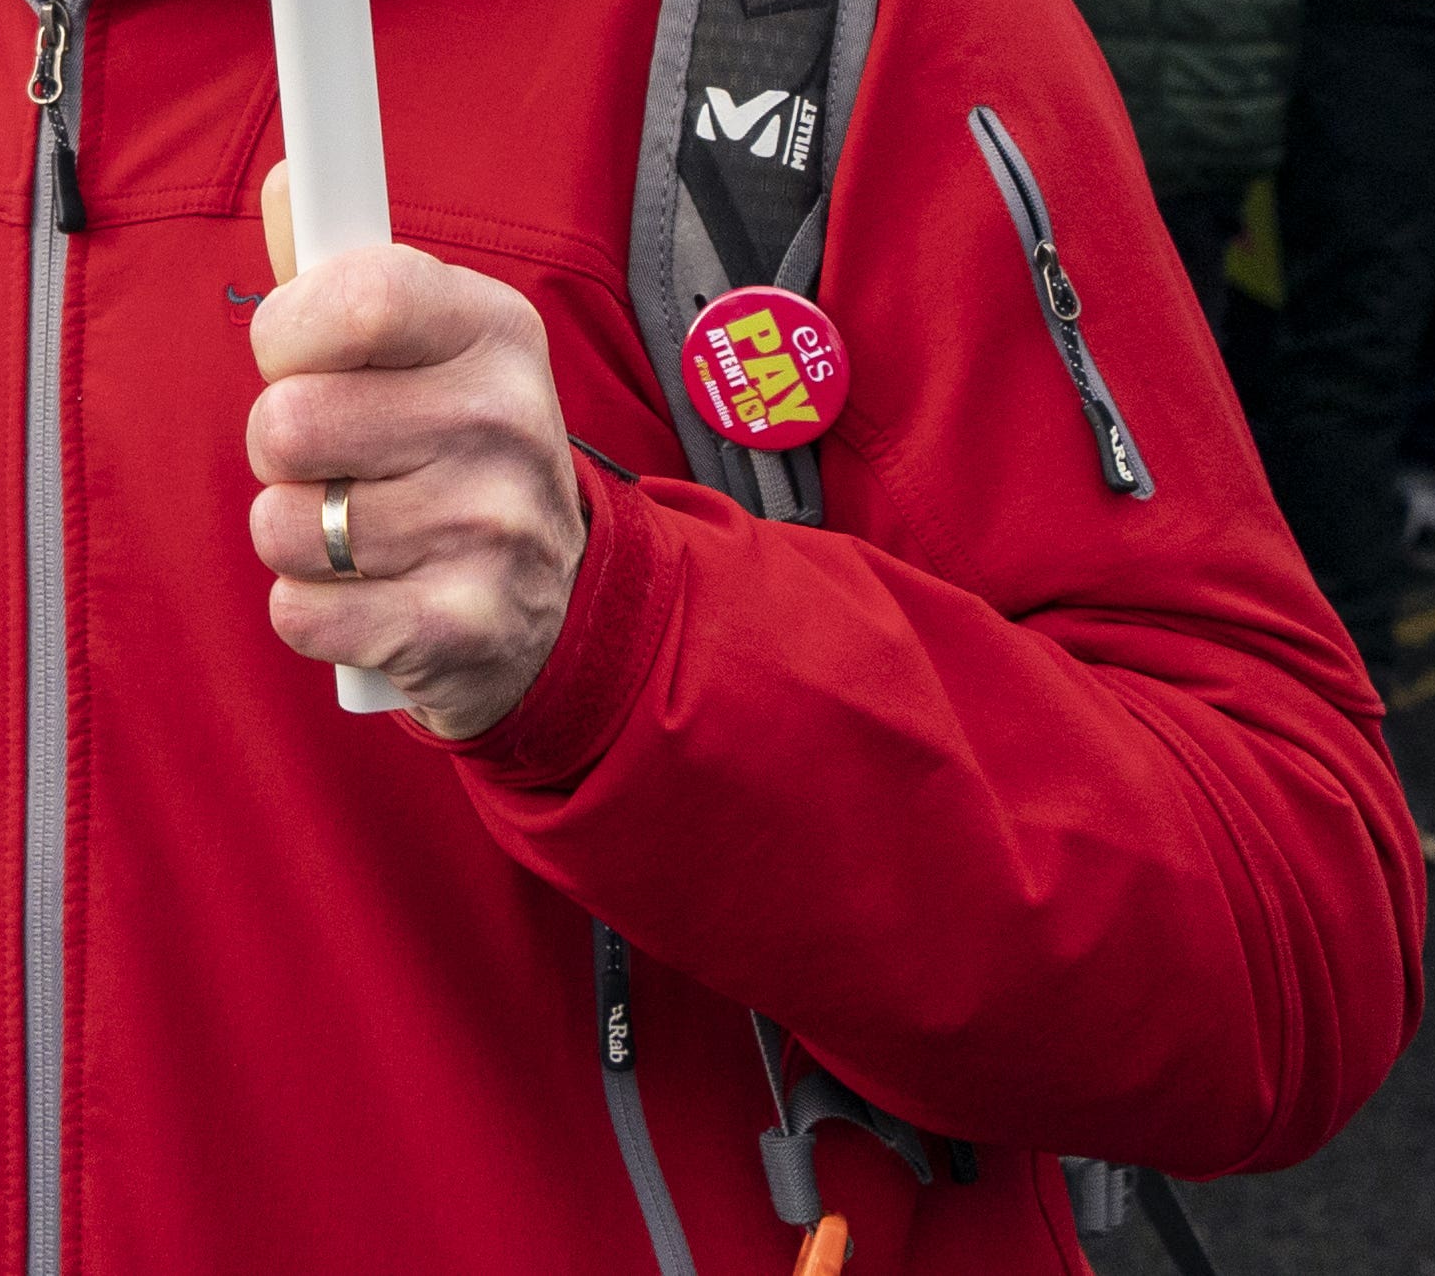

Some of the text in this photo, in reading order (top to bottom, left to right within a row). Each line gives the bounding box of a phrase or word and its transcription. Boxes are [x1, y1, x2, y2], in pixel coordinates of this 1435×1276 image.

[789, 98, 818, 171] MILLET
[725, 308, 822, 427] PAY
[791, 325, 834, 383] eis
[608, 1022, 630, 1064] Rab
